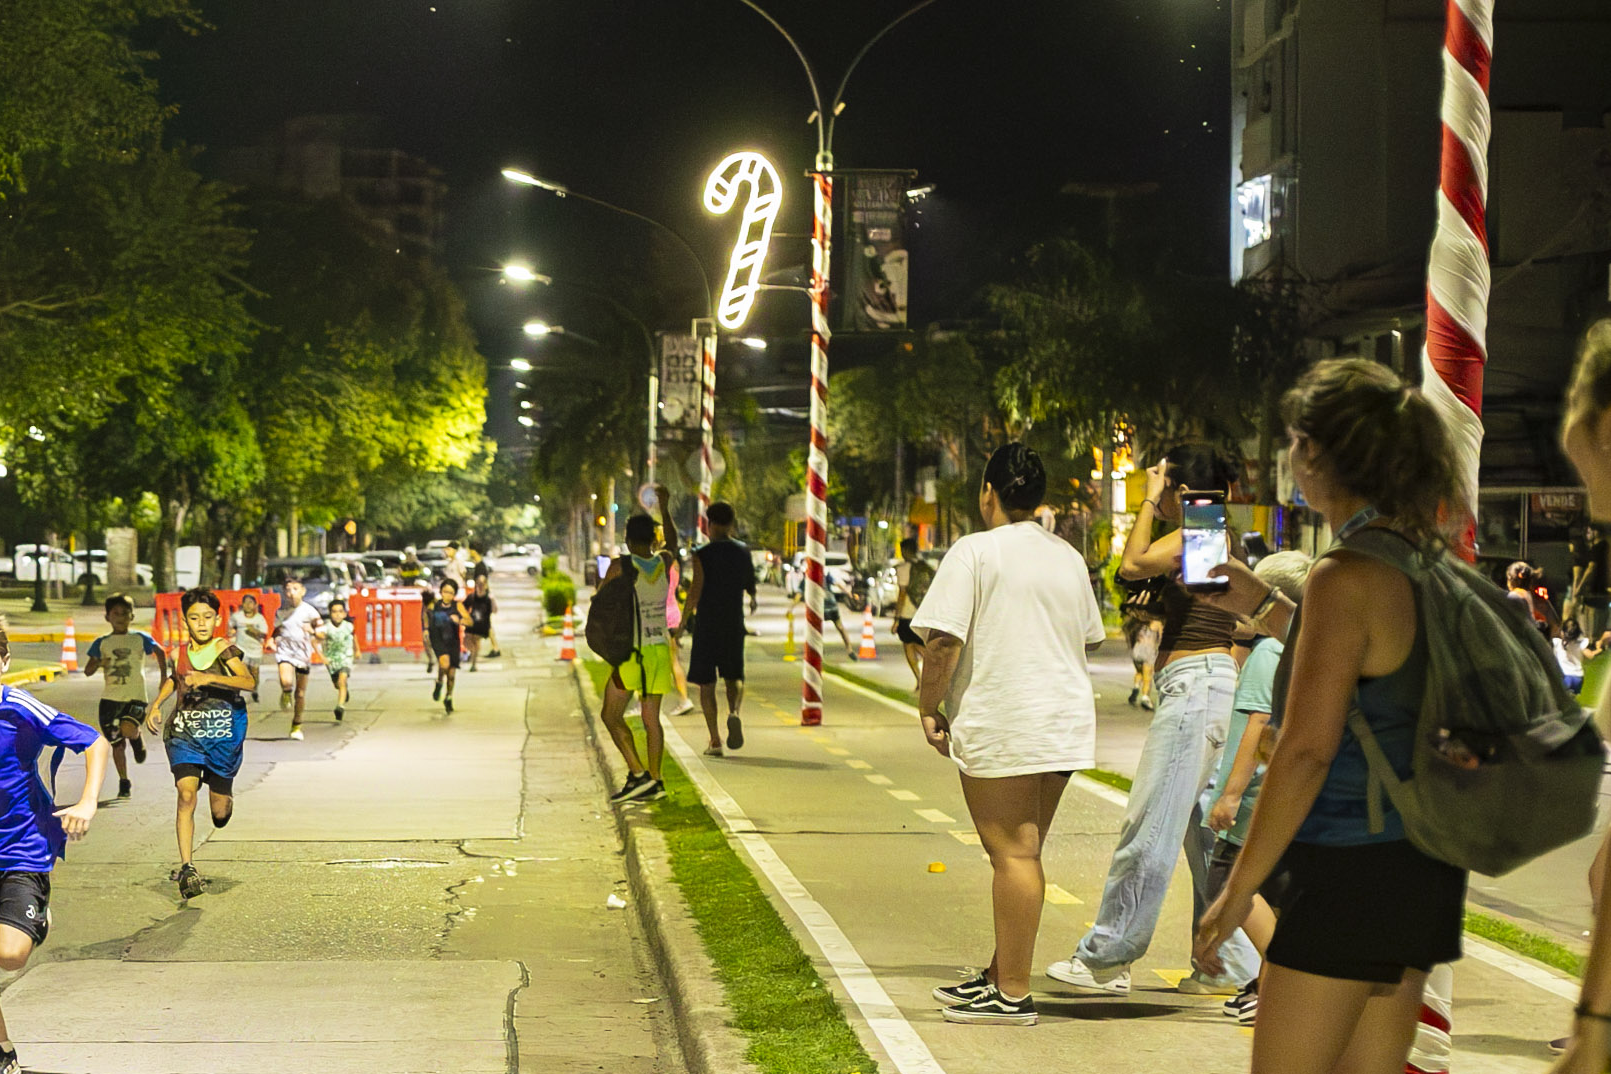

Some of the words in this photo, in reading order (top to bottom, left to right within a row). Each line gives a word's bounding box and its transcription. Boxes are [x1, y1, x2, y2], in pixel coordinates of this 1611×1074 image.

[181, 709, 232, 720] FONDO
[206, 718, 233, 728] LOS
[192, 728, 234, 738] OCOS
